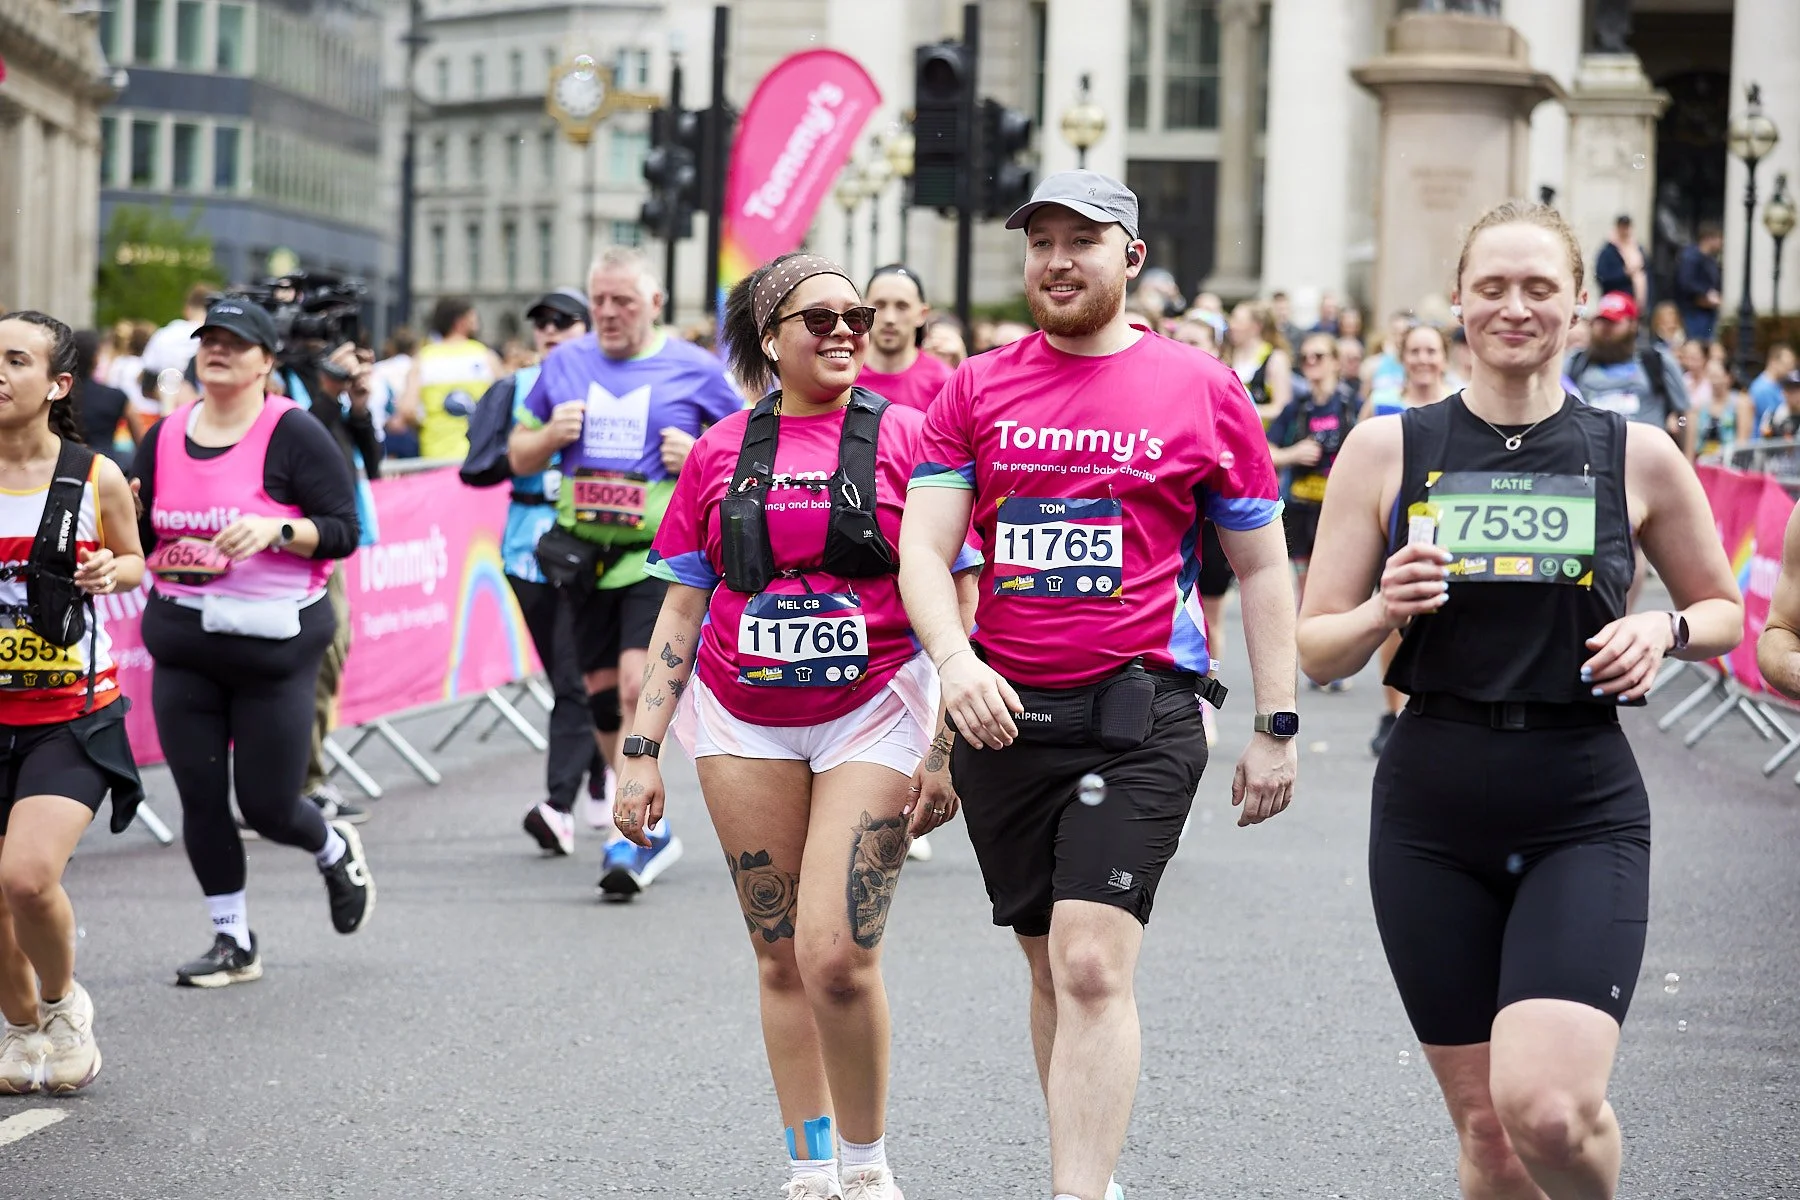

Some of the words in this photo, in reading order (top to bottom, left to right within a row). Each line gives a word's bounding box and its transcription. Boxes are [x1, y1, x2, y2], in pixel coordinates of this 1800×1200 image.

[743, 81, 844, 219] Tommy's
[994, 420, 1165, 462] Tommy's
[992, 462, 1008, 471] The
[1010, 463, 1067, 474] pregnancy
[1070, 464, 1091, 474] and
[1119, 465, 1157, 483] charity
[1491, 478, 1533, 491] KATIE
[577, 483, 641, 507] 15024
[787, 500, 809, 509] and
[811, 500, 832, 510] bab
[155, 506, 241, 531] newlif
[1039, 503, 1066, 514] TOM
[1454, 505, 1568, 542] 7539
[1004, 528, 1113, 562] 11765
[777, 599, 801, 610] MEL
[803, 599, 820, 610] CB
[747, 620, 859, 654] 11766
[1014, 712, 1052, 722] KIPRUN
